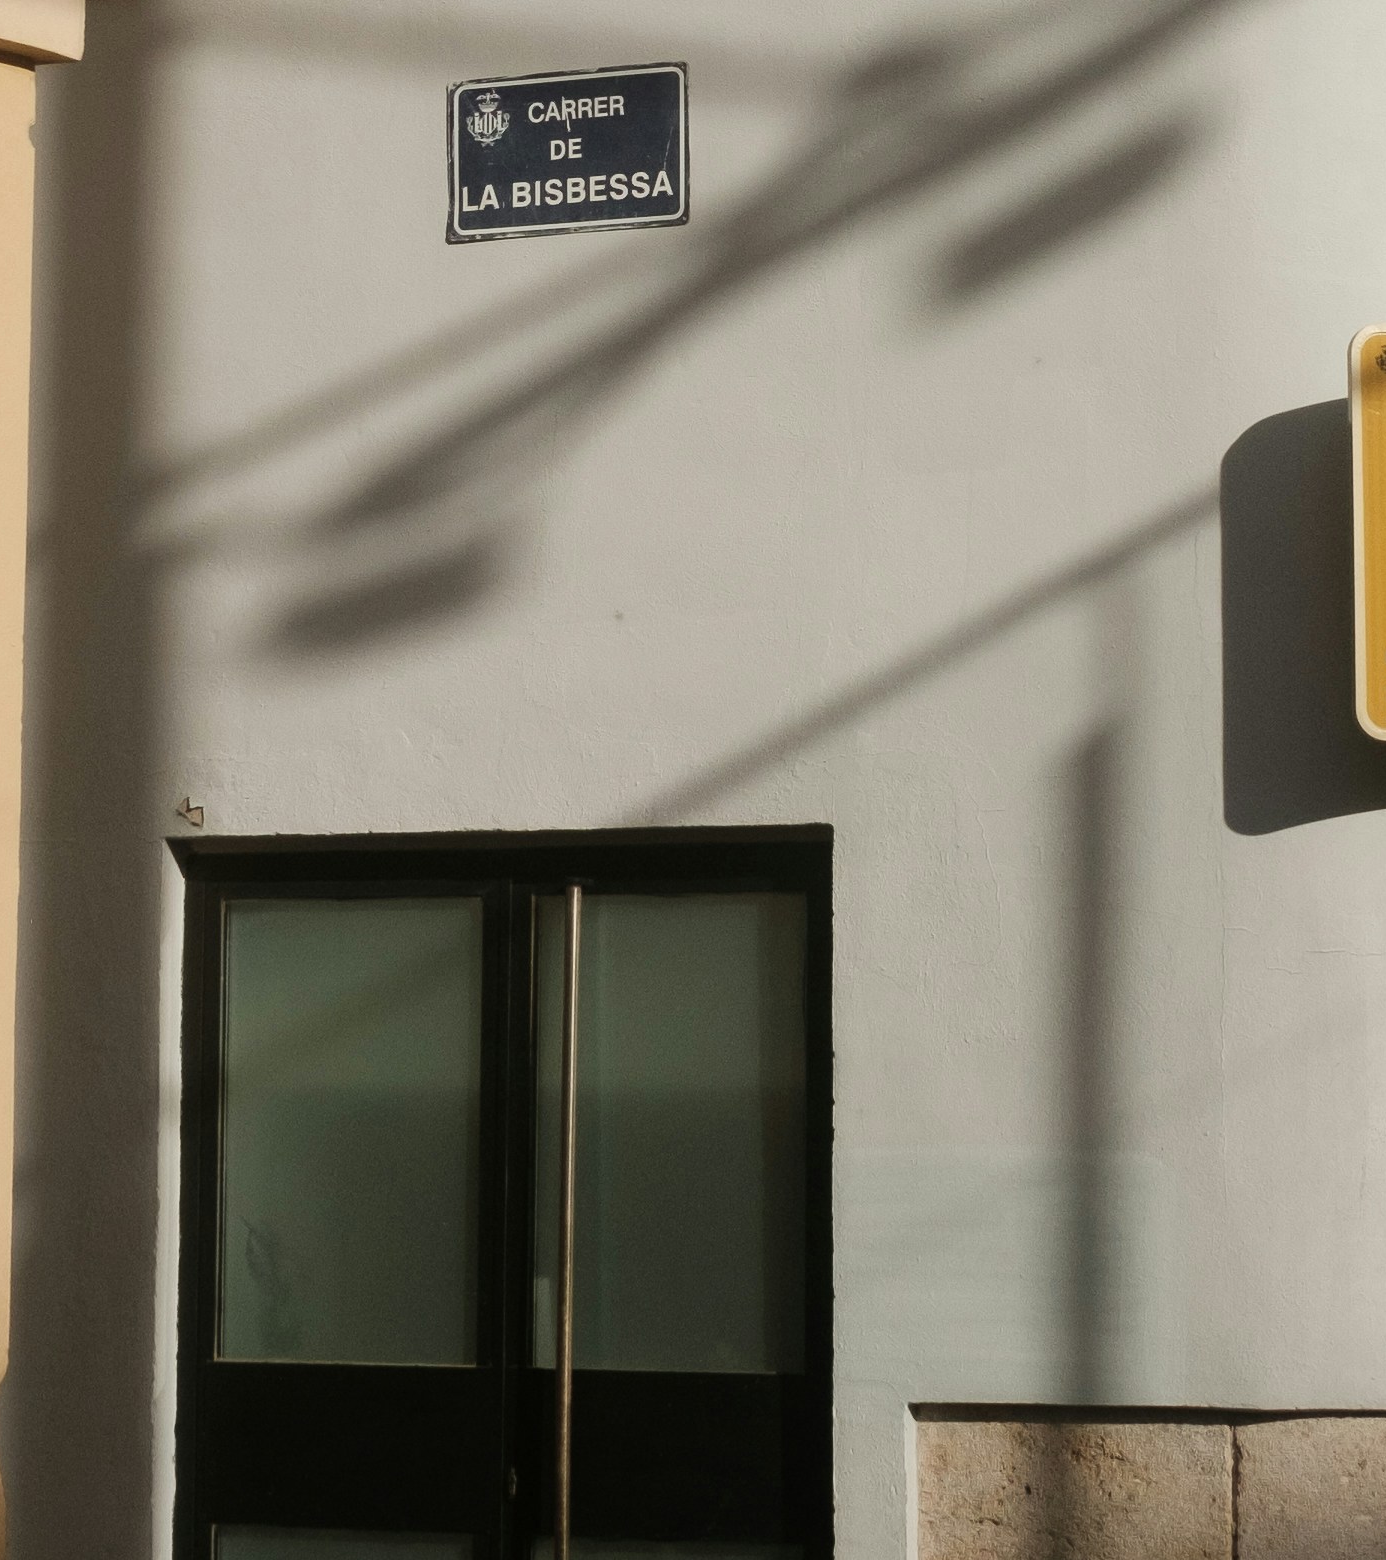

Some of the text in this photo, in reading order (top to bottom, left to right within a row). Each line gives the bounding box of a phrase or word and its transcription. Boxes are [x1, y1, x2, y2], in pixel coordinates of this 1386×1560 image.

[527, 95, 625, 124] CARRER
[549, 137, 583, 161] DE
[461, 170, 674, 212] LA BISBESSA
